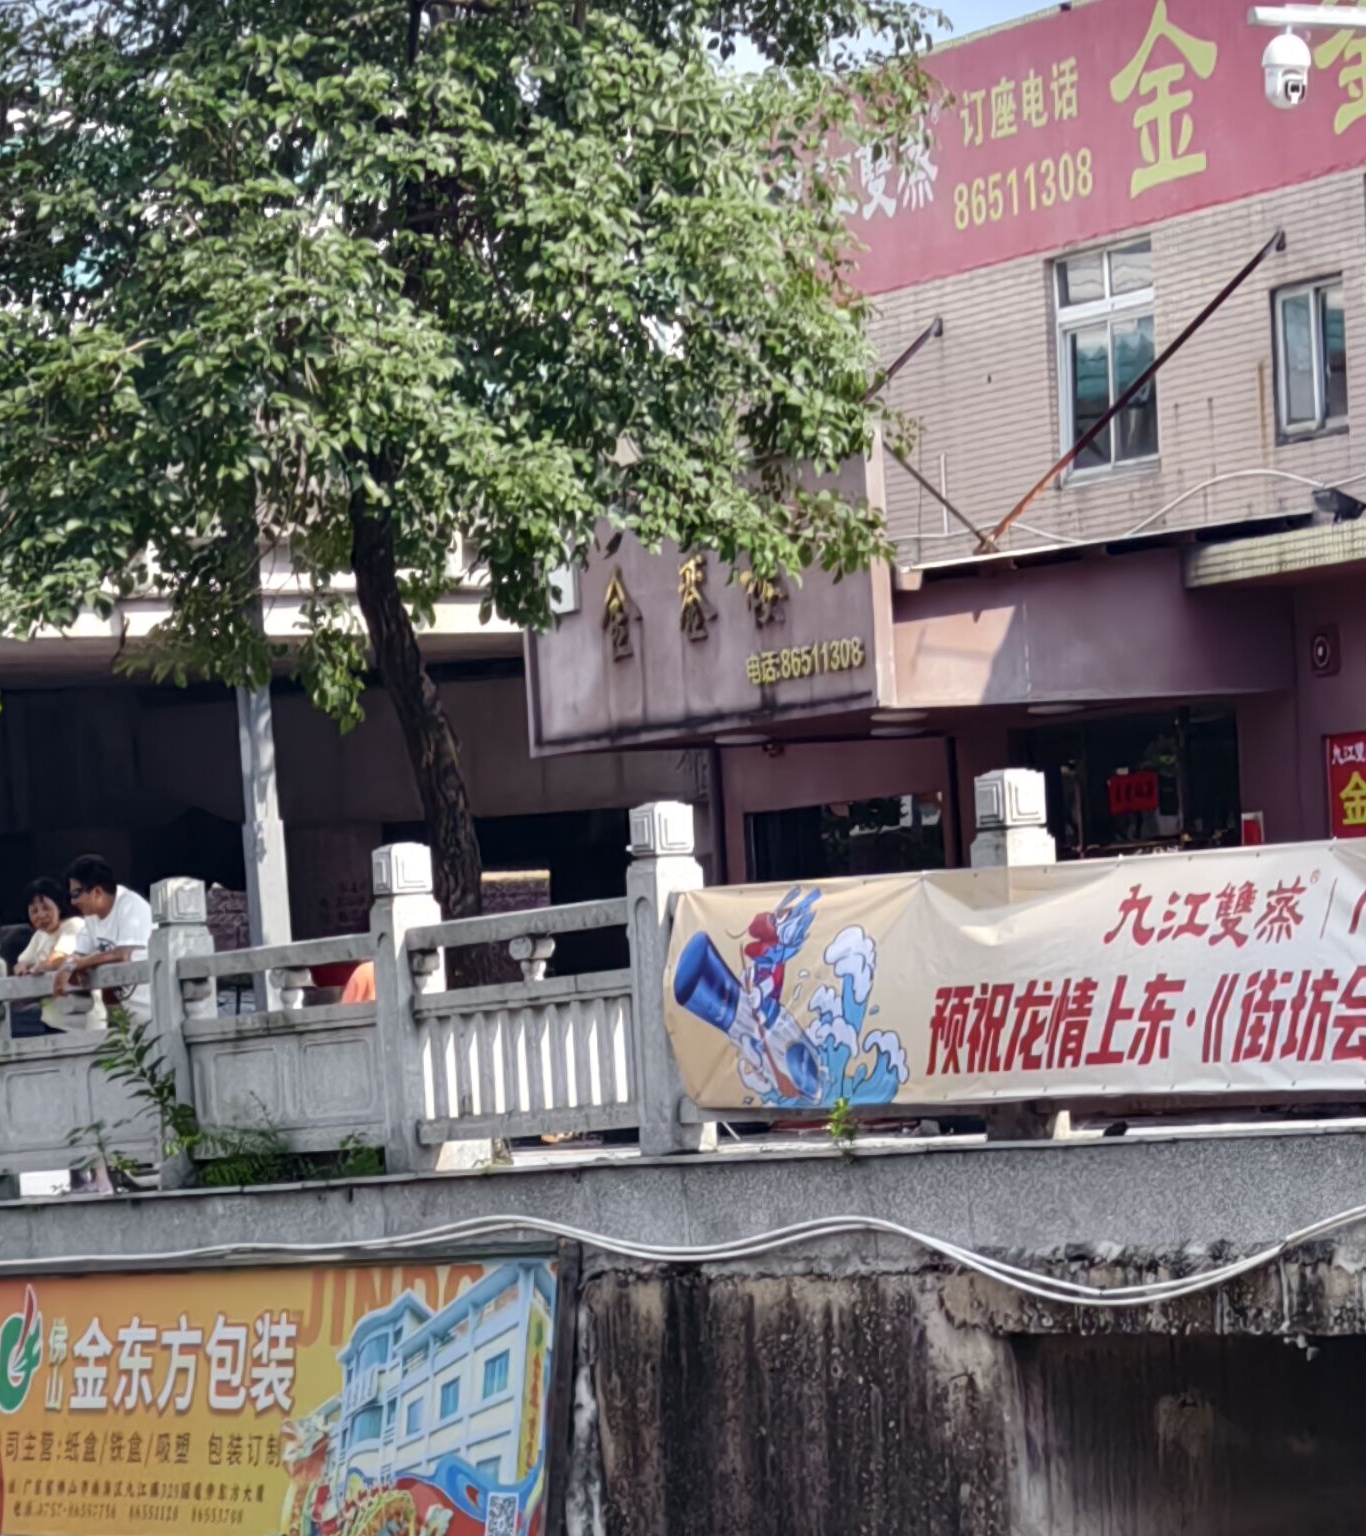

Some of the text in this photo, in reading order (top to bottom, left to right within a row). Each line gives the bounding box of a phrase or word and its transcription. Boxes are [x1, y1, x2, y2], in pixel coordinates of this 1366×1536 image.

[960, 59, 1079, 147] 订座电话
[953, 146, 1093, 231] 86511308
[69, 1311, 297, 1414] 金东方包装
